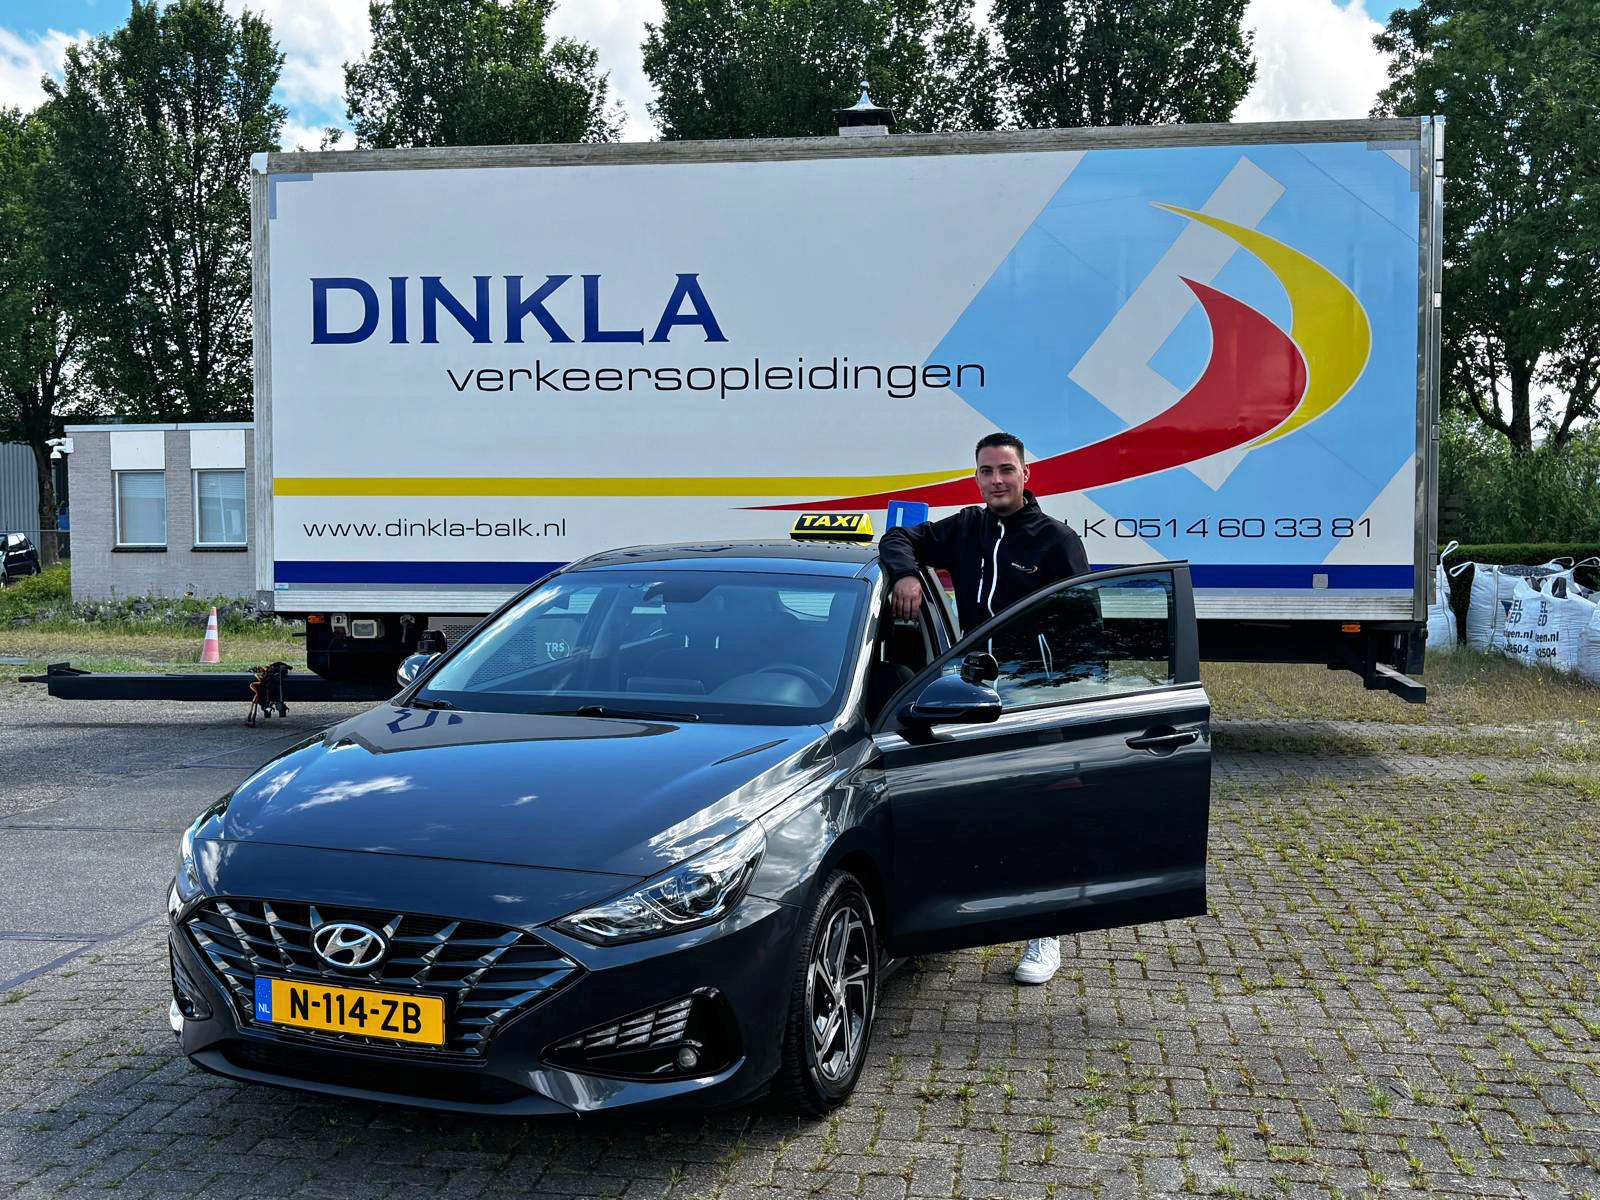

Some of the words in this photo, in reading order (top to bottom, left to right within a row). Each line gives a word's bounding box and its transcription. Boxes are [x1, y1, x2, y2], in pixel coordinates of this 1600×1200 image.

[309, 273, 729, 346] DINKLA
[446, 356, 985, 400] verkeersopleidingen
[303, 518, 566, 537] www.dinkla-balk.nl
[802, 515, 861, 527] TAXI
[1114, 518, 1209, 538] 0514
[1218, 518, 1266, 538] 60
[1274, 517, 1322, 538] 33
[1331, 517, 1372, 538] 81
[544, 642, 566, 652] TRS
[258, 1002, 271, 1014] NL
[289, 987, 422, 1034] N-114-ZB
